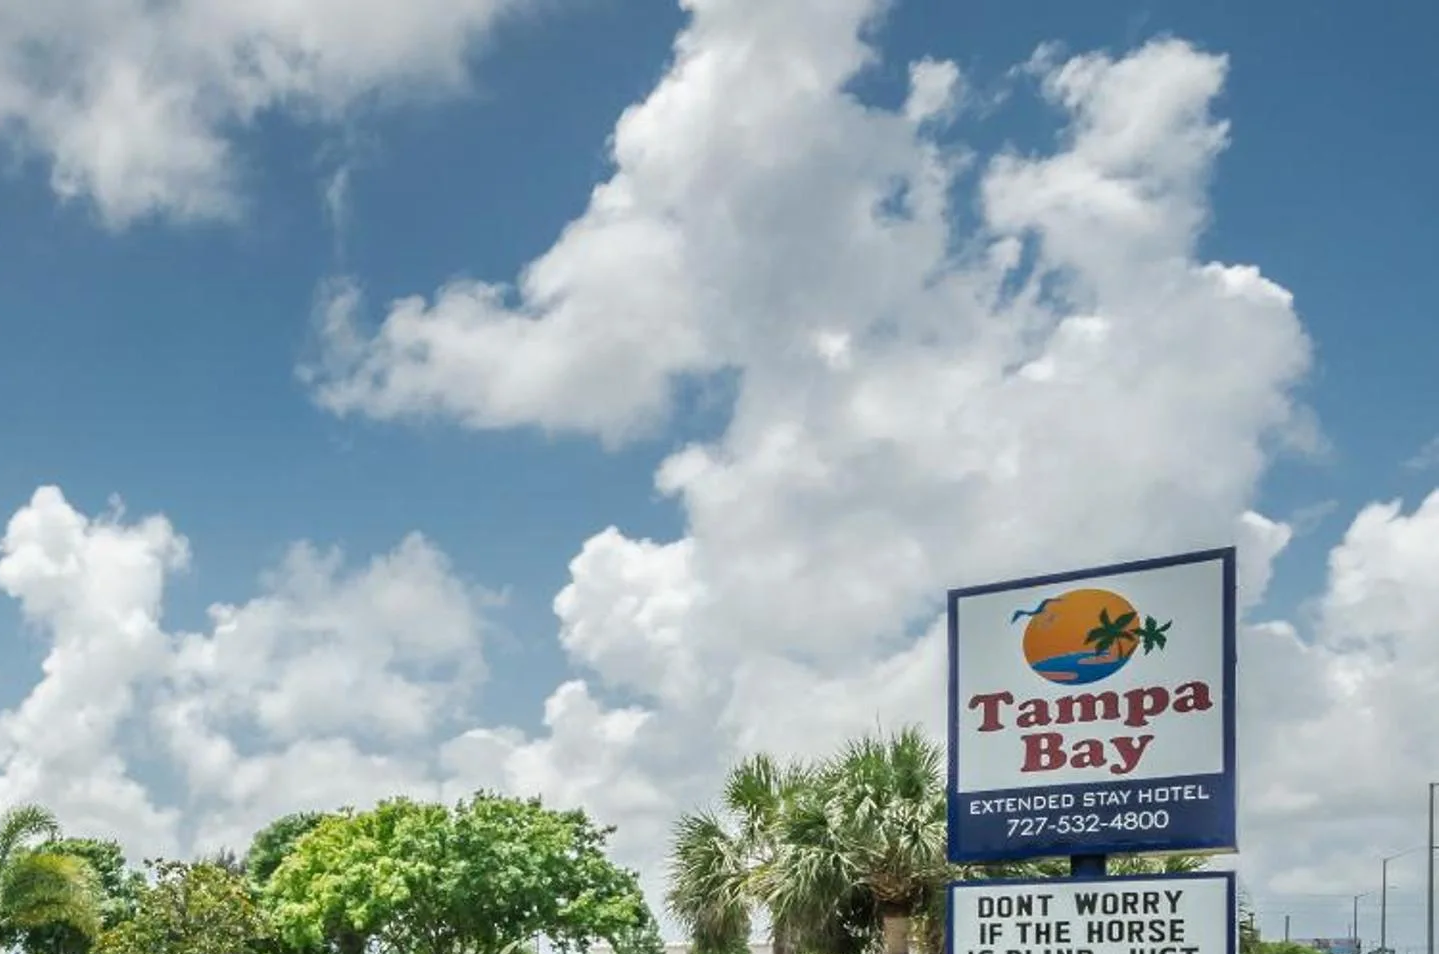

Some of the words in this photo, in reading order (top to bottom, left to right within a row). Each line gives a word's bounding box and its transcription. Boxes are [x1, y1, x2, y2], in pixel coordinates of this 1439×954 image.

[968, 680, 1213, 732] Tampa
[1020, 732, 1154, 775] Bay
[970, 793, 1074, 815] EXTENDED
[1083, 789, 1131, 807] STAY
[1138, 785, 1209, 802] HOTEL
[1007, 810, 1169, 838] 727-532-4800
[977, 894, 1053, 918] DONT
[1074, 890, 1183, 916] WORRY
[980, 922, 1003, 945] IF
[1016, 921, 1071, 944] THE
[1087, 919, 1185, 943] HORSE
